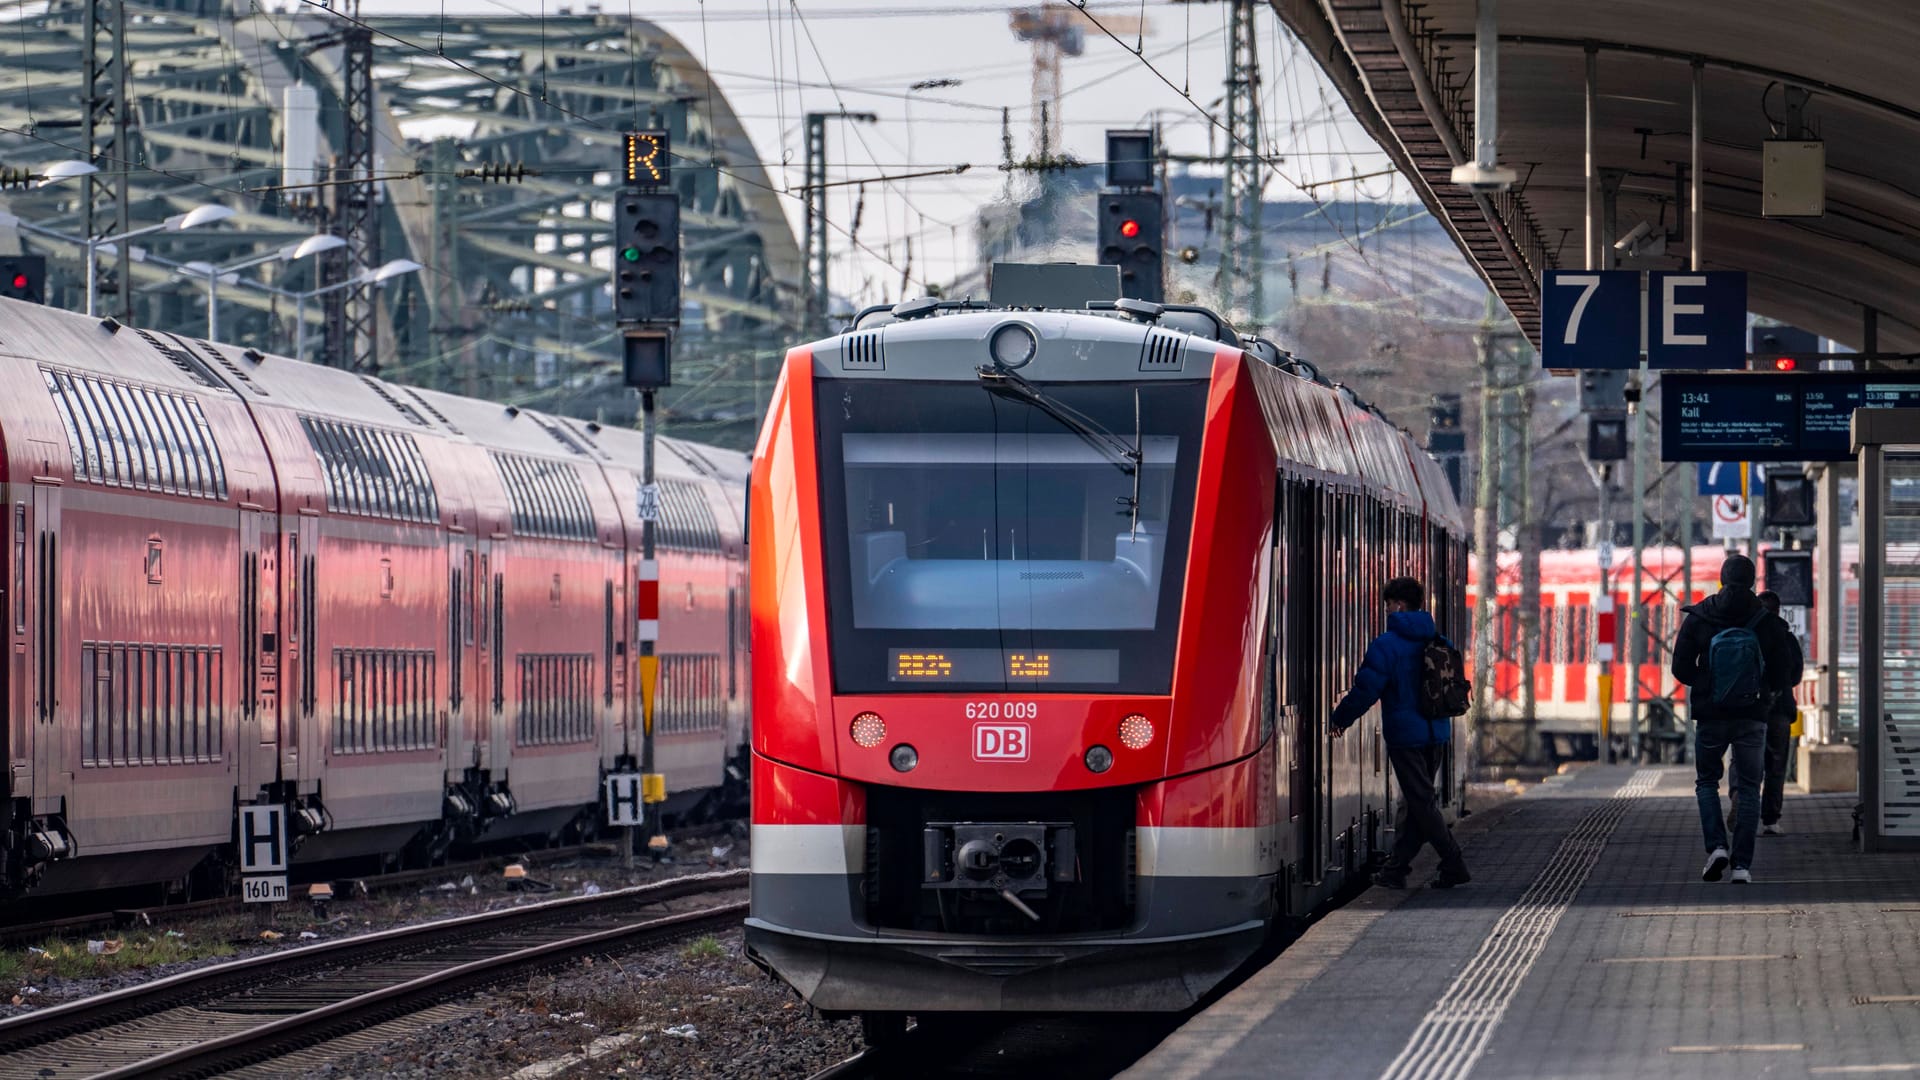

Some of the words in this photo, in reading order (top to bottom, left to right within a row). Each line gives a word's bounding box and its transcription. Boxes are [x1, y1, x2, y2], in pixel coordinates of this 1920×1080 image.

[629, 135, 660, 180] R
[1555, 275, 1601, 345] 7
[1662, 275, 1708, 345] E
[1681, 393, 1709, 404] 13:41
[1681, 407, 1700, 418] Kall
[899, 655, 951, 676] RB24
[965, 702, 999, 719] 620
[1003, 702, 1038, 719] 009
[979, 728, 1025, 756] DB
[611, 779, 638, 821] H
[244, 810, 281, 866] H
[245, 880, 270, 899] 160
[273, 885, 285, 898] m
